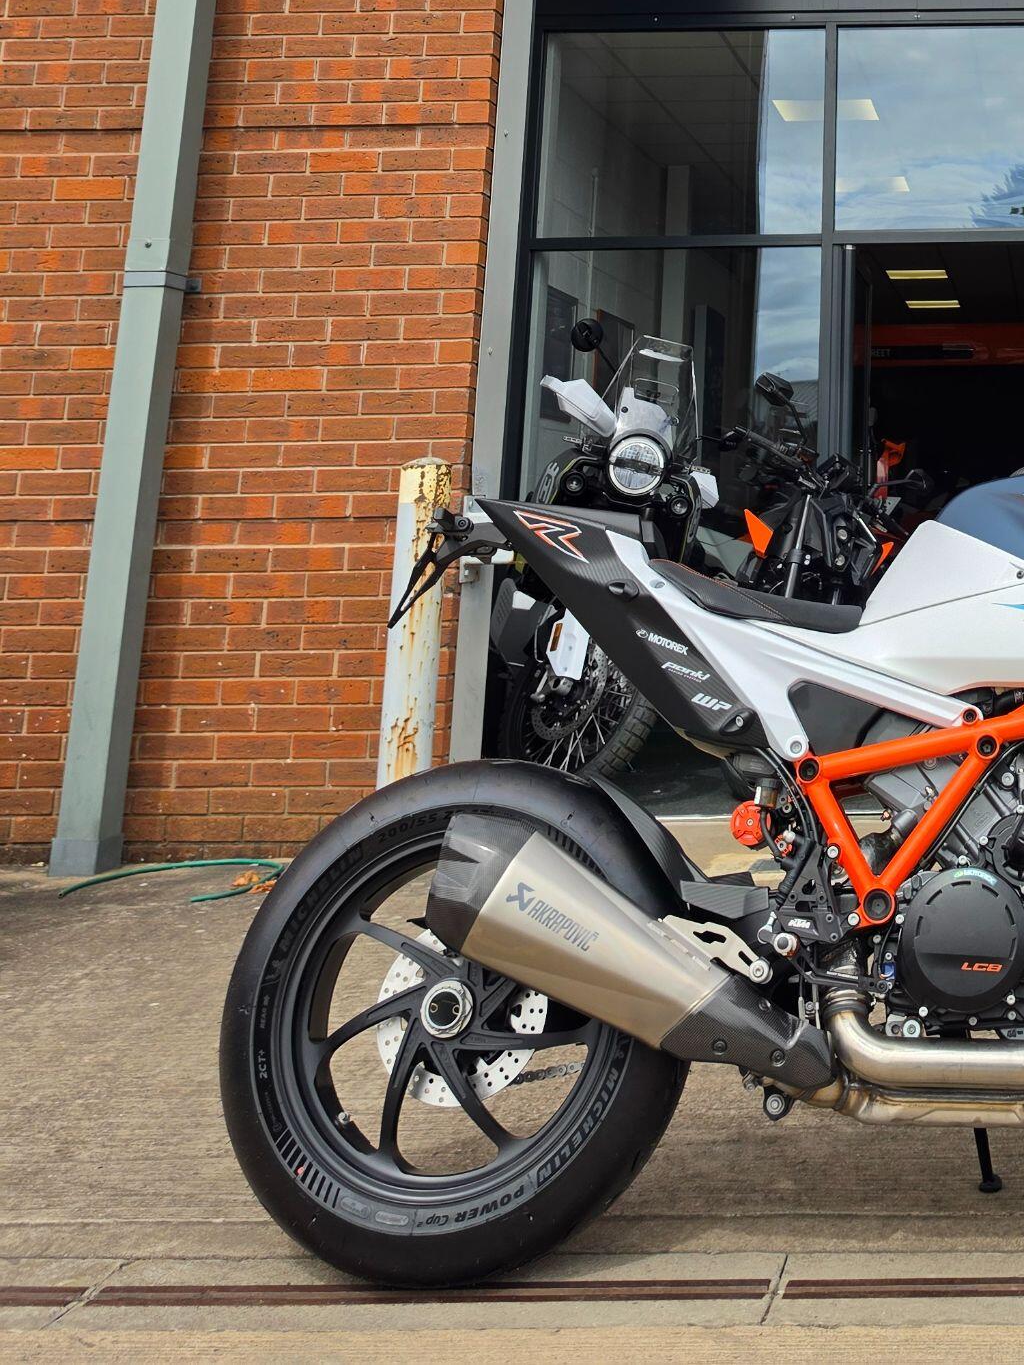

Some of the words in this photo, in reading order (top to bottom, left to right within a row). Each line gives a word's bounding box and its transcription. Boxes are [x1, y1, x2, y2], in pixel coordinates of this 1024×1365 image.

[647, 632, 689, 656] MOTOREX
[691, 692, 733, 711] WP
[379, 812, 438, 842] 200/55
[278, 845, 365, 954] MICHELIN
[787, 918, 812, 929] KTM
[536, 1066, 621, 1184] MICHELIN
[454, 1183, 526, 1223] POWER
